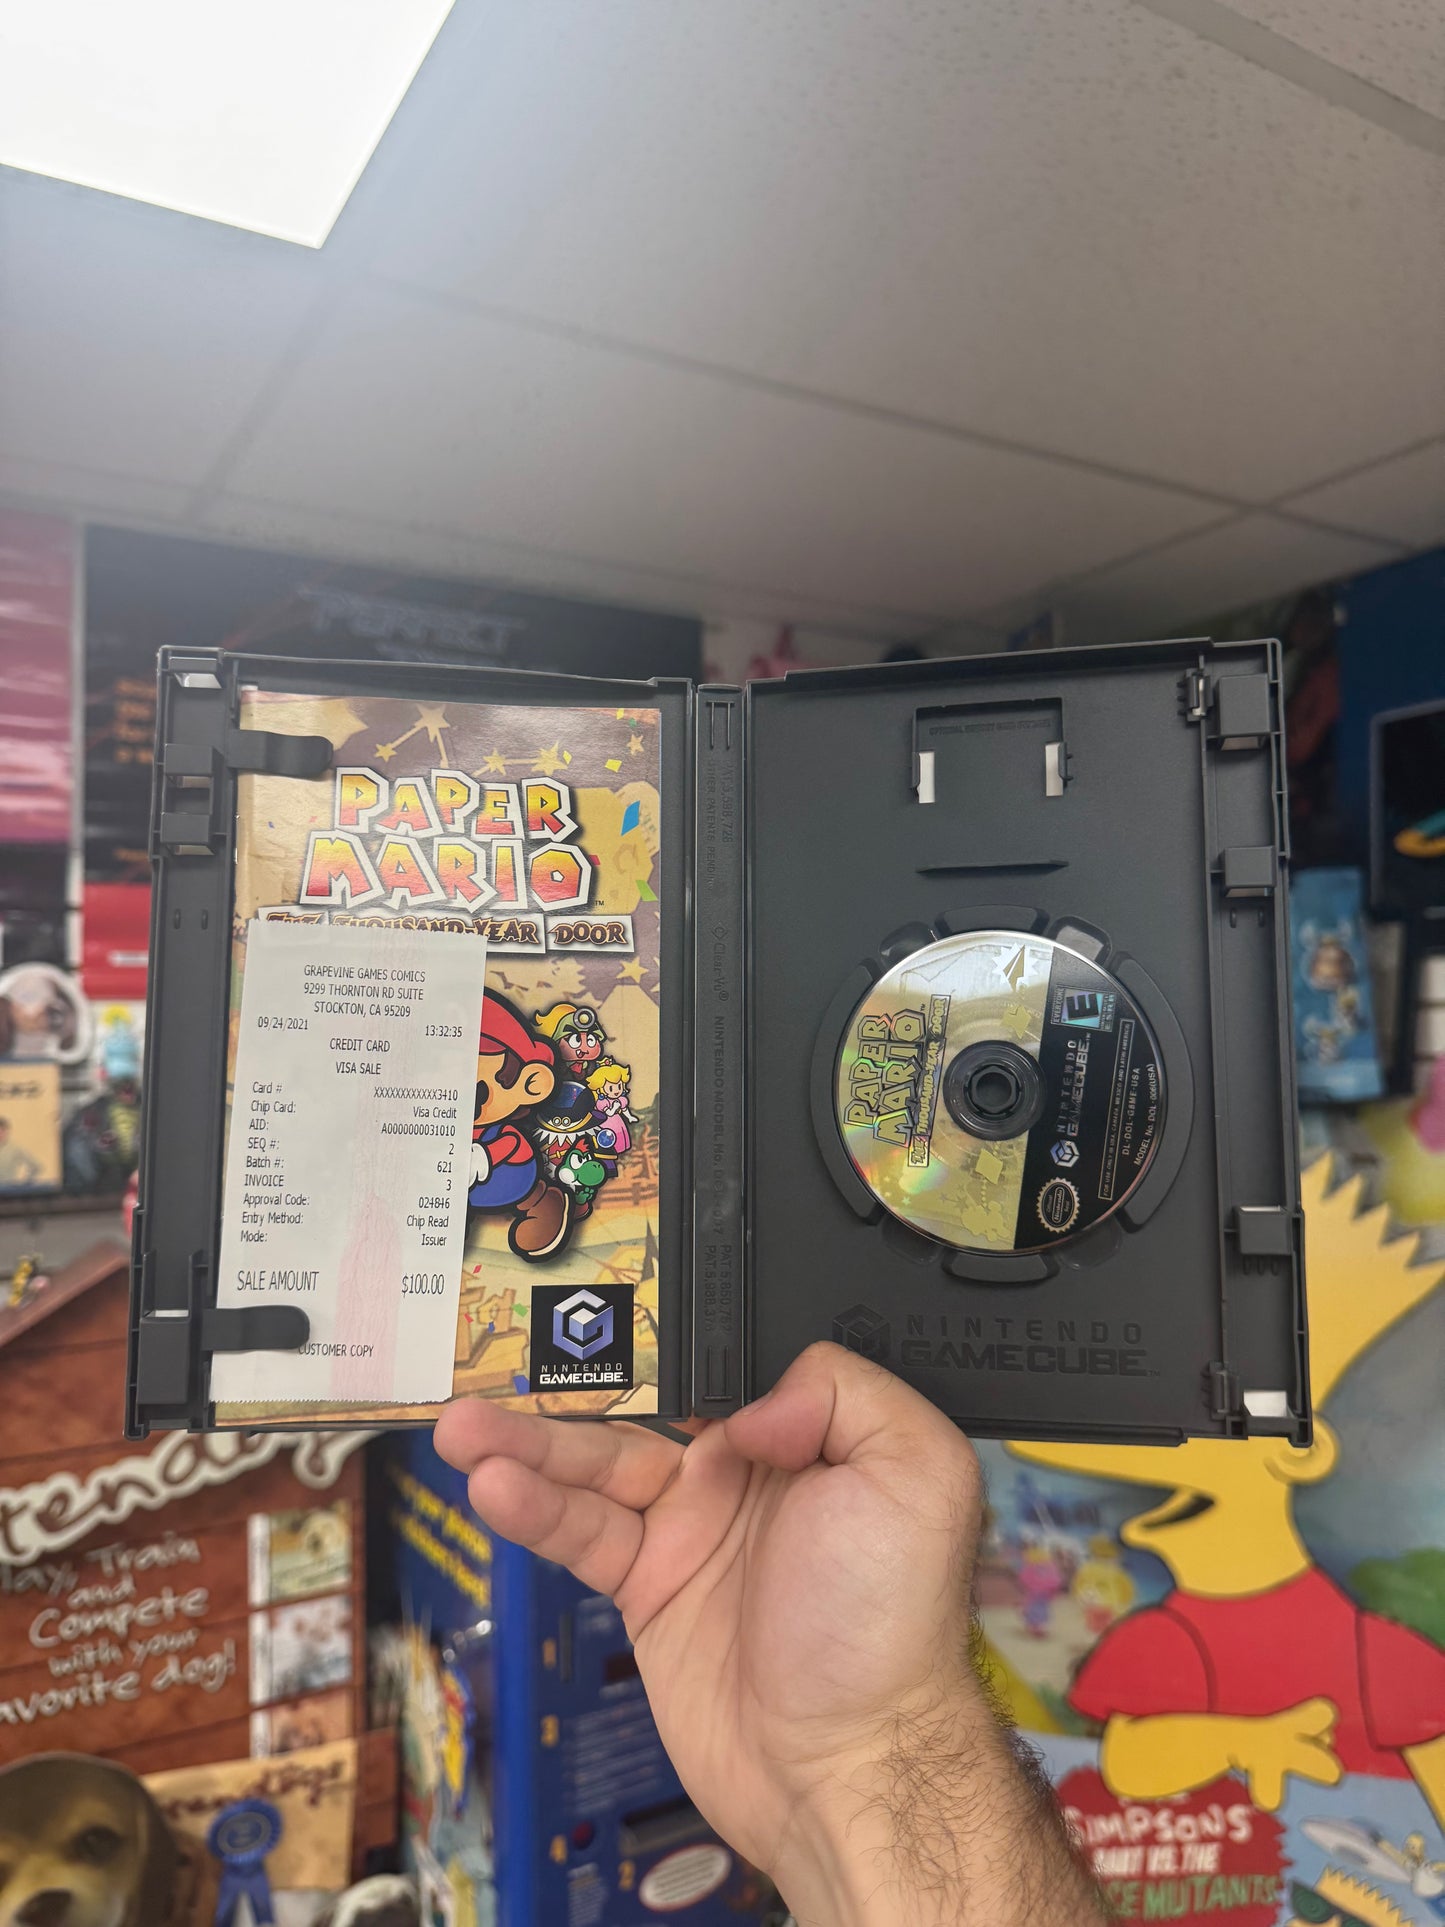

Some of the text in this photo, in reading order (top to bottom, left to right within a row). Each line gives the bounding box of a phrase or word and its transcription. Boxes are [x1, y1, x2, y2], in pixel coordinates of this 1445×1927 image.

[335, 767, 579, 842] PAPER
[300, 830, 592, 912] MARIO
[550, 921, 628, 946] DOOR
[304, 964, 426, 982] GRAPEVINE GAMES COMICS
[304, 982, 424, 1000] 9299 THORNTON RD SUITE
[314, 1002, 411, 1018] STOCKTON, CA 95209
[1053, 988, 1066, 1022] EVERYONE
[257, 1016, 309, 1030] 09/24/2021
[424, 1024, 463, 1038] 13:32:35
[329, 1038, 391, 1052] CREDIT CARD
[714, 1016, 725, 1088] NINTENDO
[336, 1061, 382, 1075] VISA SALE
[844, 1014, 891, 1128] PAPER
[873, 1008, 926, 1148] MARIO
[252, 1082, 274, 1094] Card
[1056, 1040, 1077, 1133] NINTENDO
[250, 1100, 296, 1114] Chip Card:
[412, 1106, 457, 1119] Visa Credit
[714, 1092, 725, 1138] MODEL
[249, 1118, 269, 1130] AID:
[248, 1138, 266, 1152] SEQ
[448, 1144, 455, 1155] 2
[1134, 1138, 1150, 1166] MODEL
[246, 1156, 270, 1168] Batch
[436, 1161, 452, 1174] 621
[244, 1174, 284, 1187] INVOICE
[446, 1179, 452, 1191] 3
[243, 1194, 310, 1208] Approval Code:
[418, 1196, 450, 1209] 024846
[242, 1212, 304, 1226] Entry Method:
[406, 1215, 449, 1228] Chip Read
[240, 1230, 268, 1242] Mode:
[421, 1234, 448, 1246] Issuer
[237, 1270, 319, 1291] SALE AMOUNT
[402, 1274, 444, 1298] $100.00
[906, 1314, 1142, 1344] NINTENDO
[298, 1344, 374, 1358] CUSTOMER COPY
[902, 1340, 1148, 1376] GAMECUBE
[542, 1362, 622, 1373] NINTENDO
[540, 1372, 624, 1384] GAMECUBE
[0, 1532, 200, 1597] lay, Train
[67, 1574, 136, 1609] and
[29, 1586, 209, 1648] Compete
[48, 1627, 200, 1677] with your
[0, 1637, 236, 1724] avorite dog!
[1064, 1803, 1253, 1846] SIMPSONS
[1143, 1873, 1280, 1920] MUTANTS
